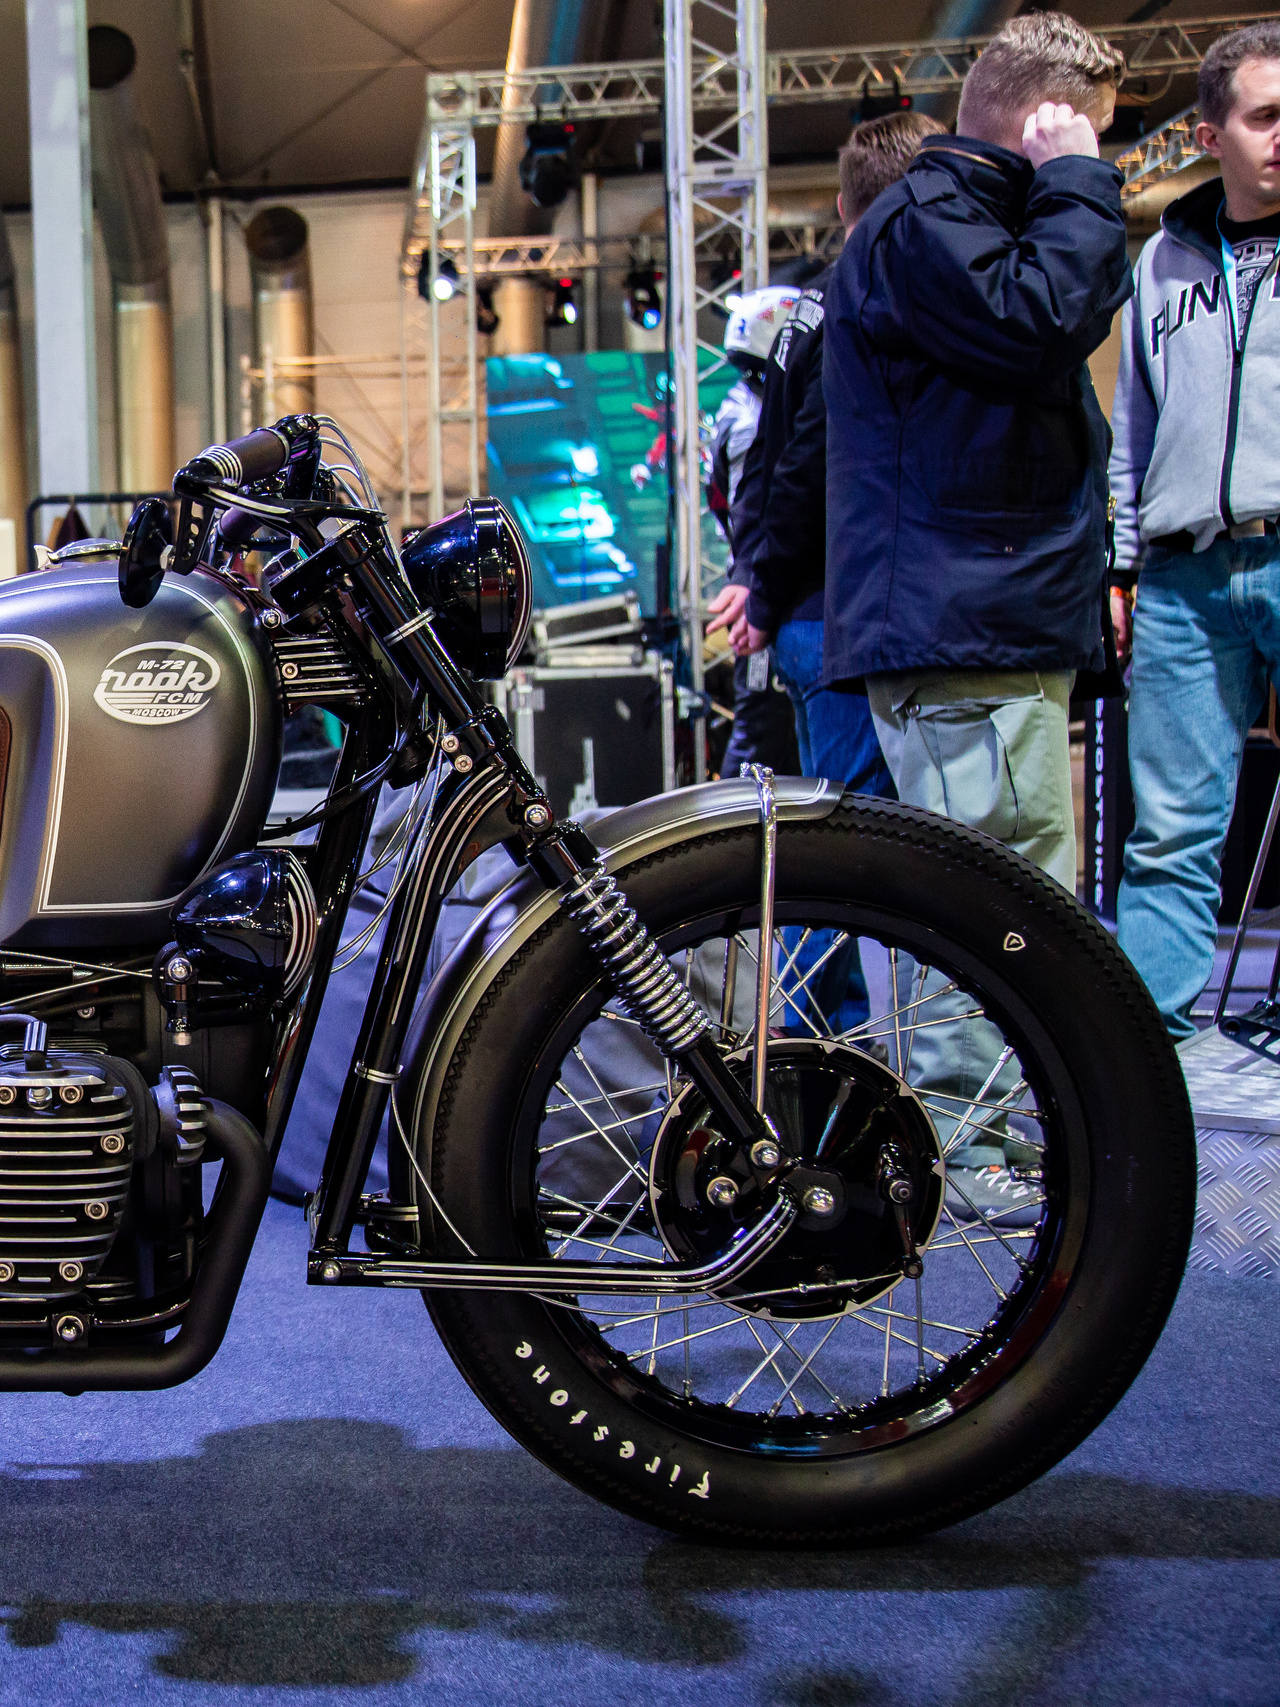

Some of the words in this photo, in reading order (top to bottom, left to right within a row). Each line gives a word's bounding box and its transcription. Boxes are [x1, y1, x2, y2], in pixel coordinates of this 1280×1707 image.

[137, 660, 186, 670] M-72
[100, 661, 210, 692] nook
[152, 692, 204, 704] FCM
[131, 708, 181, 717] MOSCOW
[515, 1341, 710, 1498] Firestone
